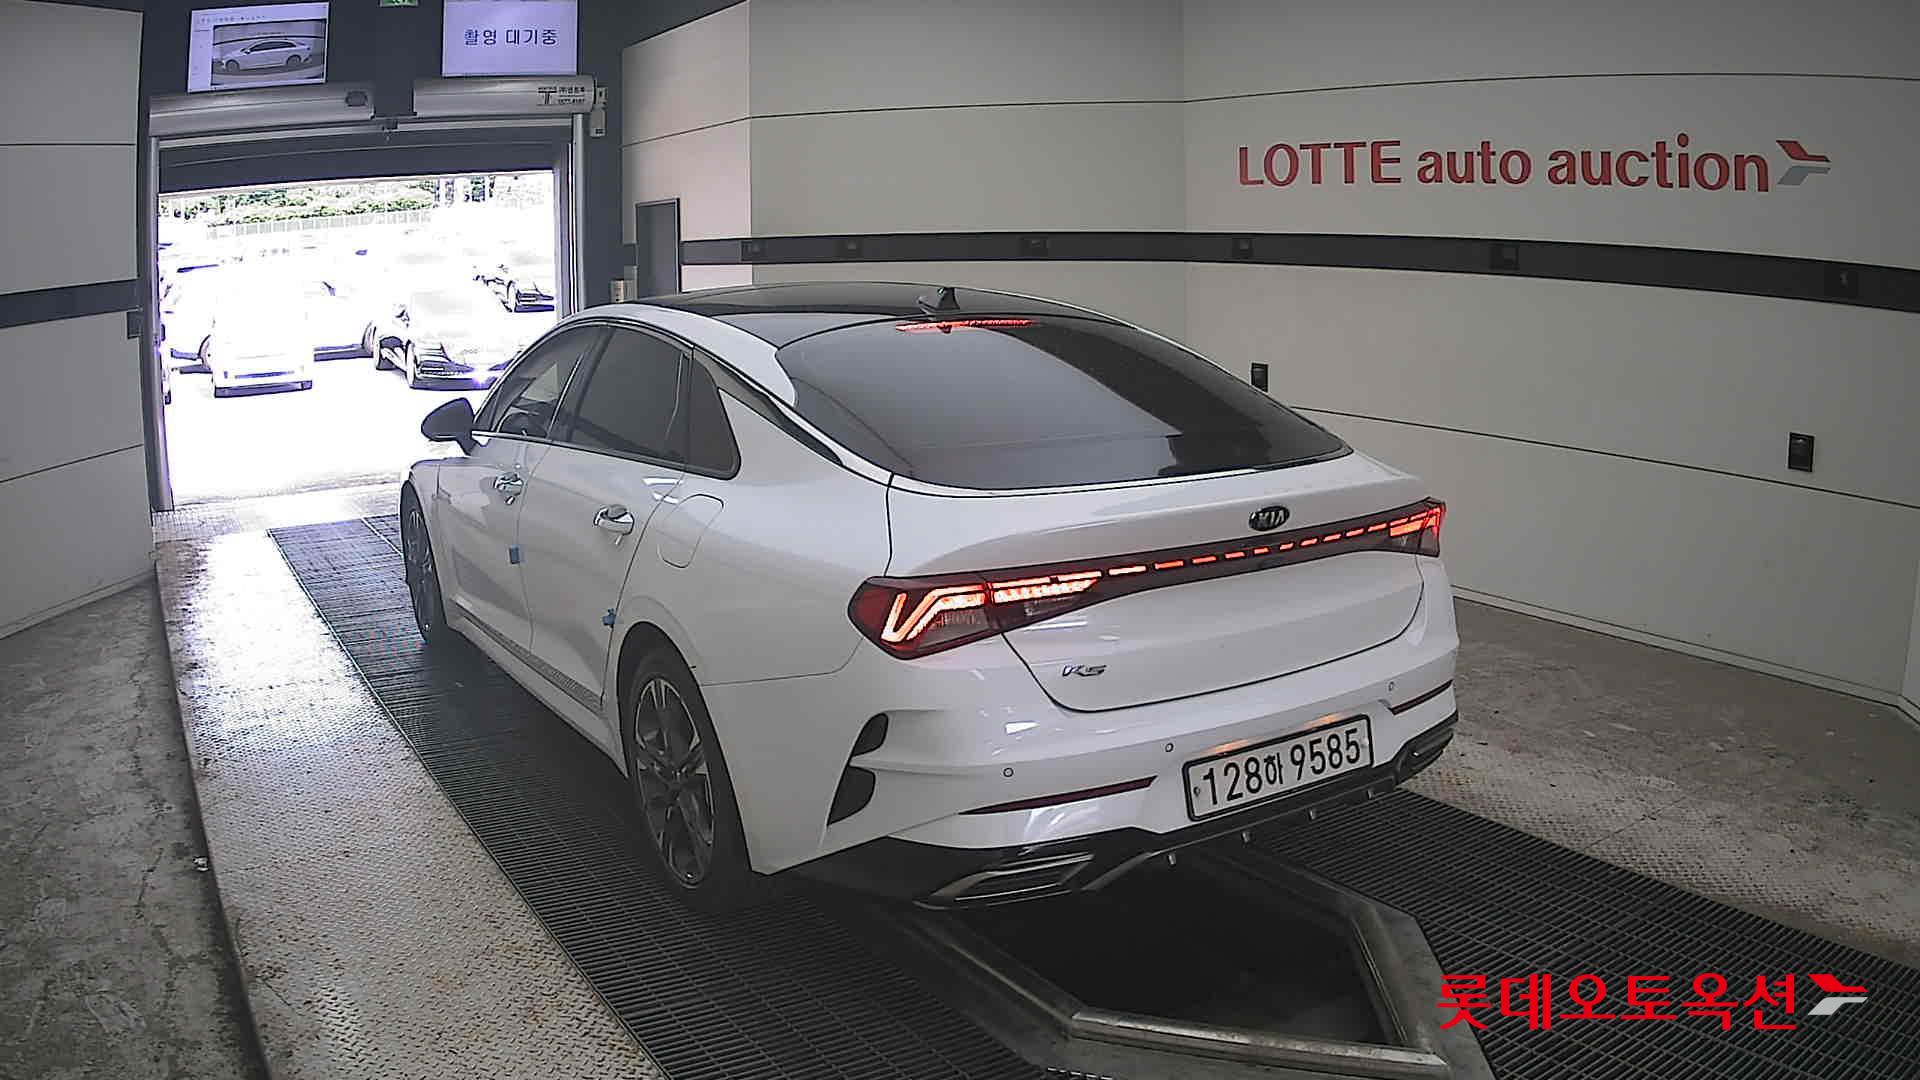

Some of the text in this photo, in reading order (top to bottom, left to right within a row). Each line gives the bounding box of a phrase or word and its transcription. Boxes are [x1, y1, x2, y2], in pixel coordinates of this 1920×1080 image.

[505, 29, 558, 46] 대기중
[1239, 134, 1770, 192] LOTTE auto auction
[1254, 509, 1287, 528] KIA
[1202, 727, 1361, 806] 128하 9585
